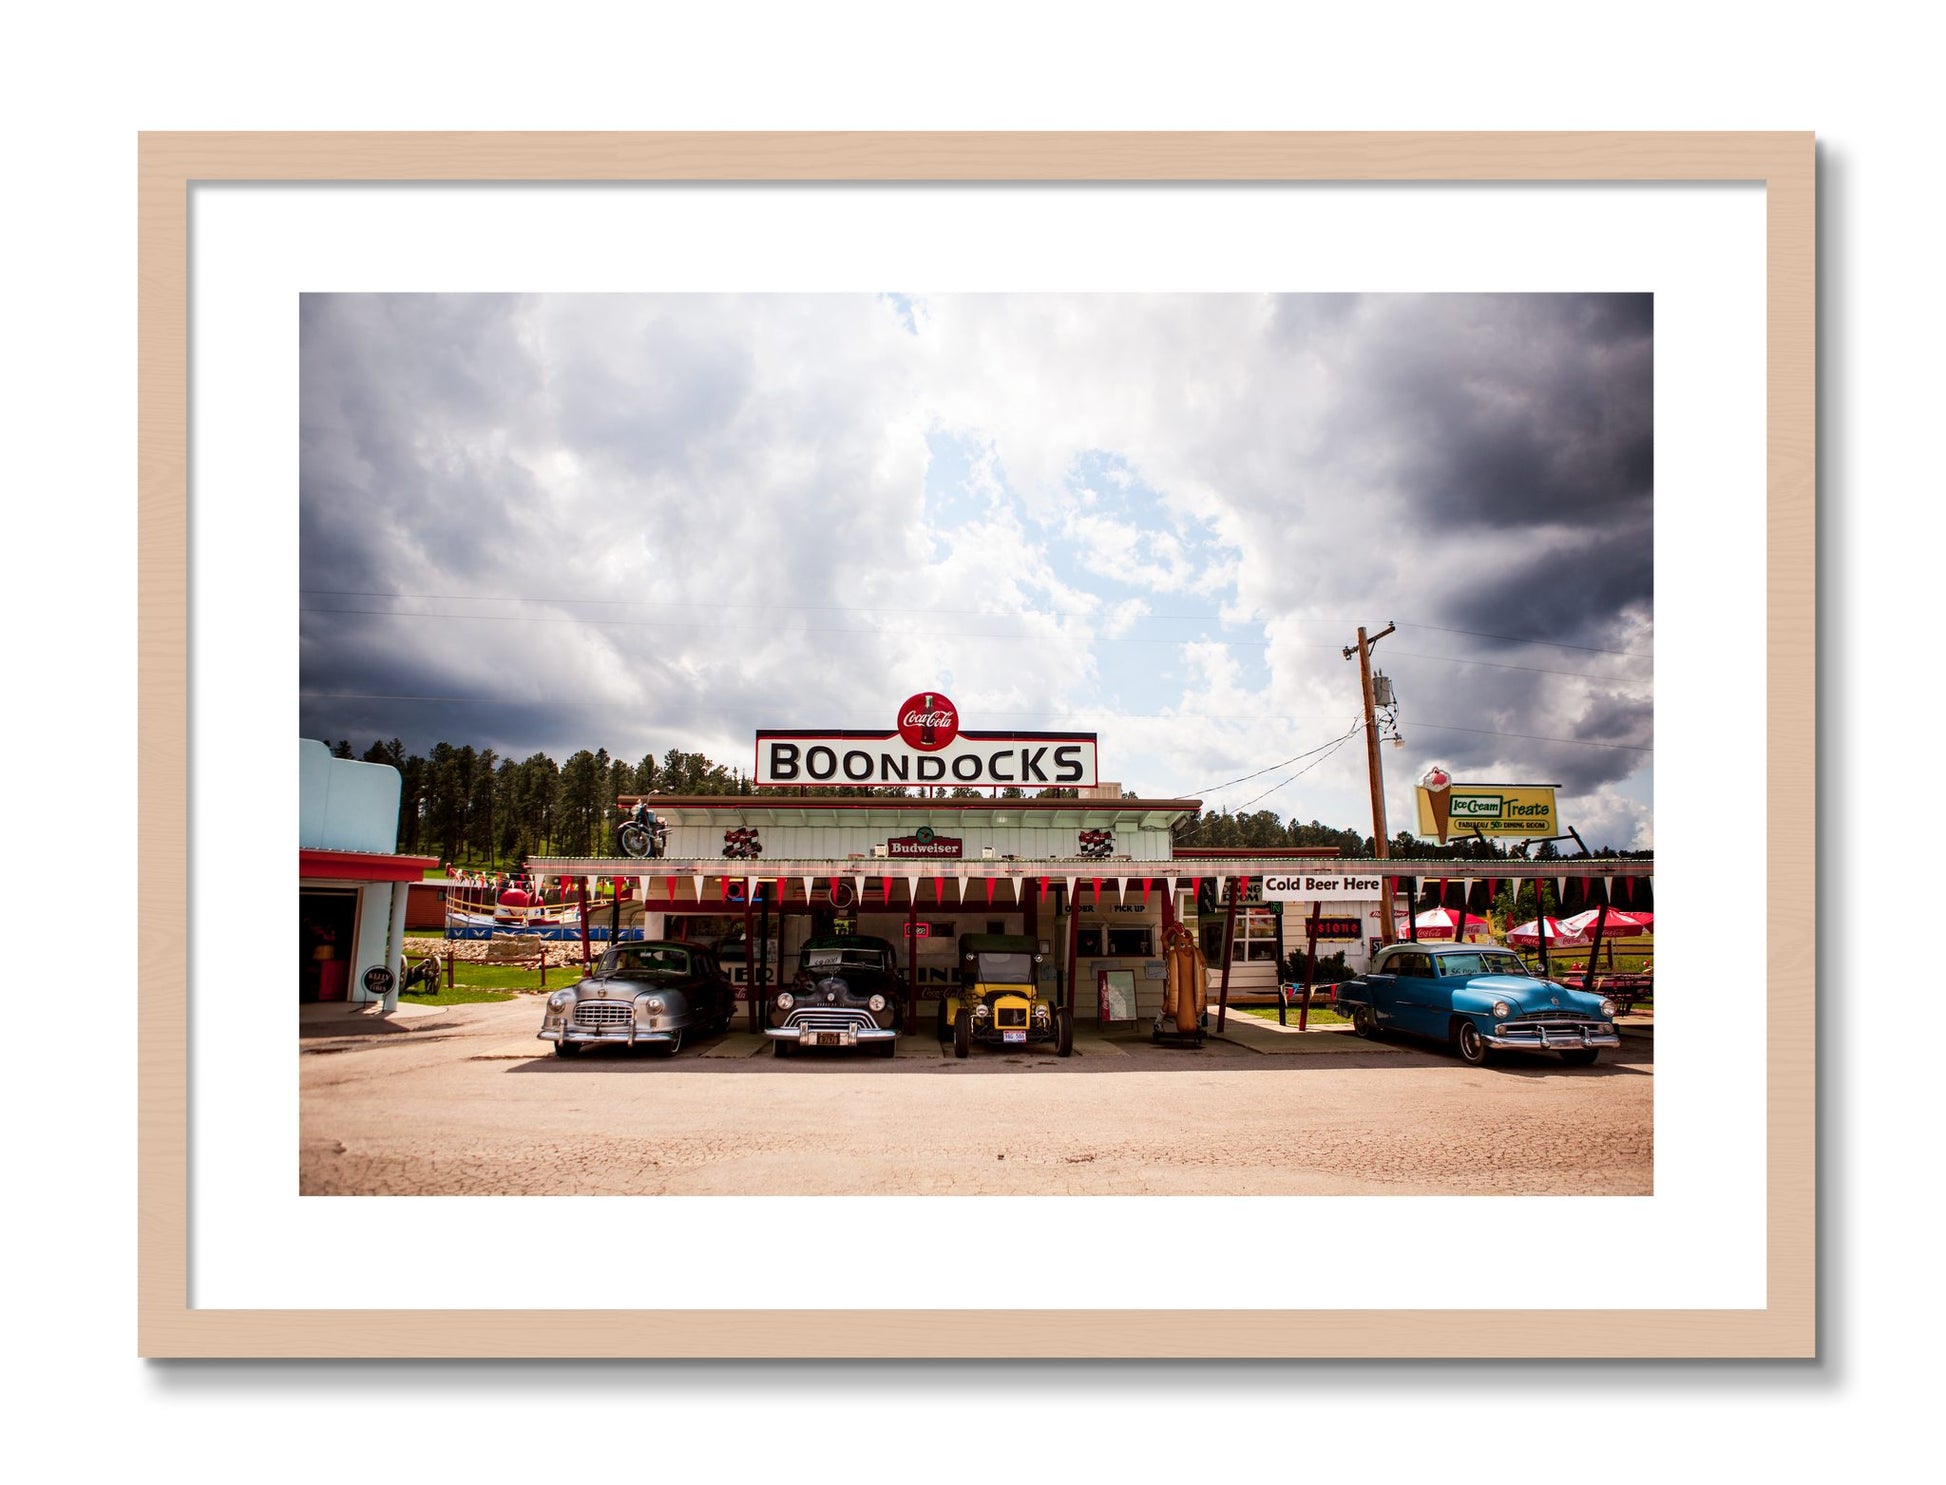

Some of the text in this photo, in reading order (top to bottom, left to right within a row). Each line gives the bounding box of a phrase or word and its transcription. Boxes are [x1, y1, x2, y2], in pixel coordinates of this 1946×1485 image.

[903, 710, 953, 728] Coca-Cola
[769, 742, 1085, 783] BOONDOCKS
[1453, 799, 1550, 818] Ice Cream Treats
[1503, 821, 1524, 830] DINING
[1525, 821, 1546, 830] ROOM
[891, 843, 959, 853] Budweiser
[1266, 877, 1380, 891] Cold Beer Here
[1114, 904, 1146, 913] PICK UP
